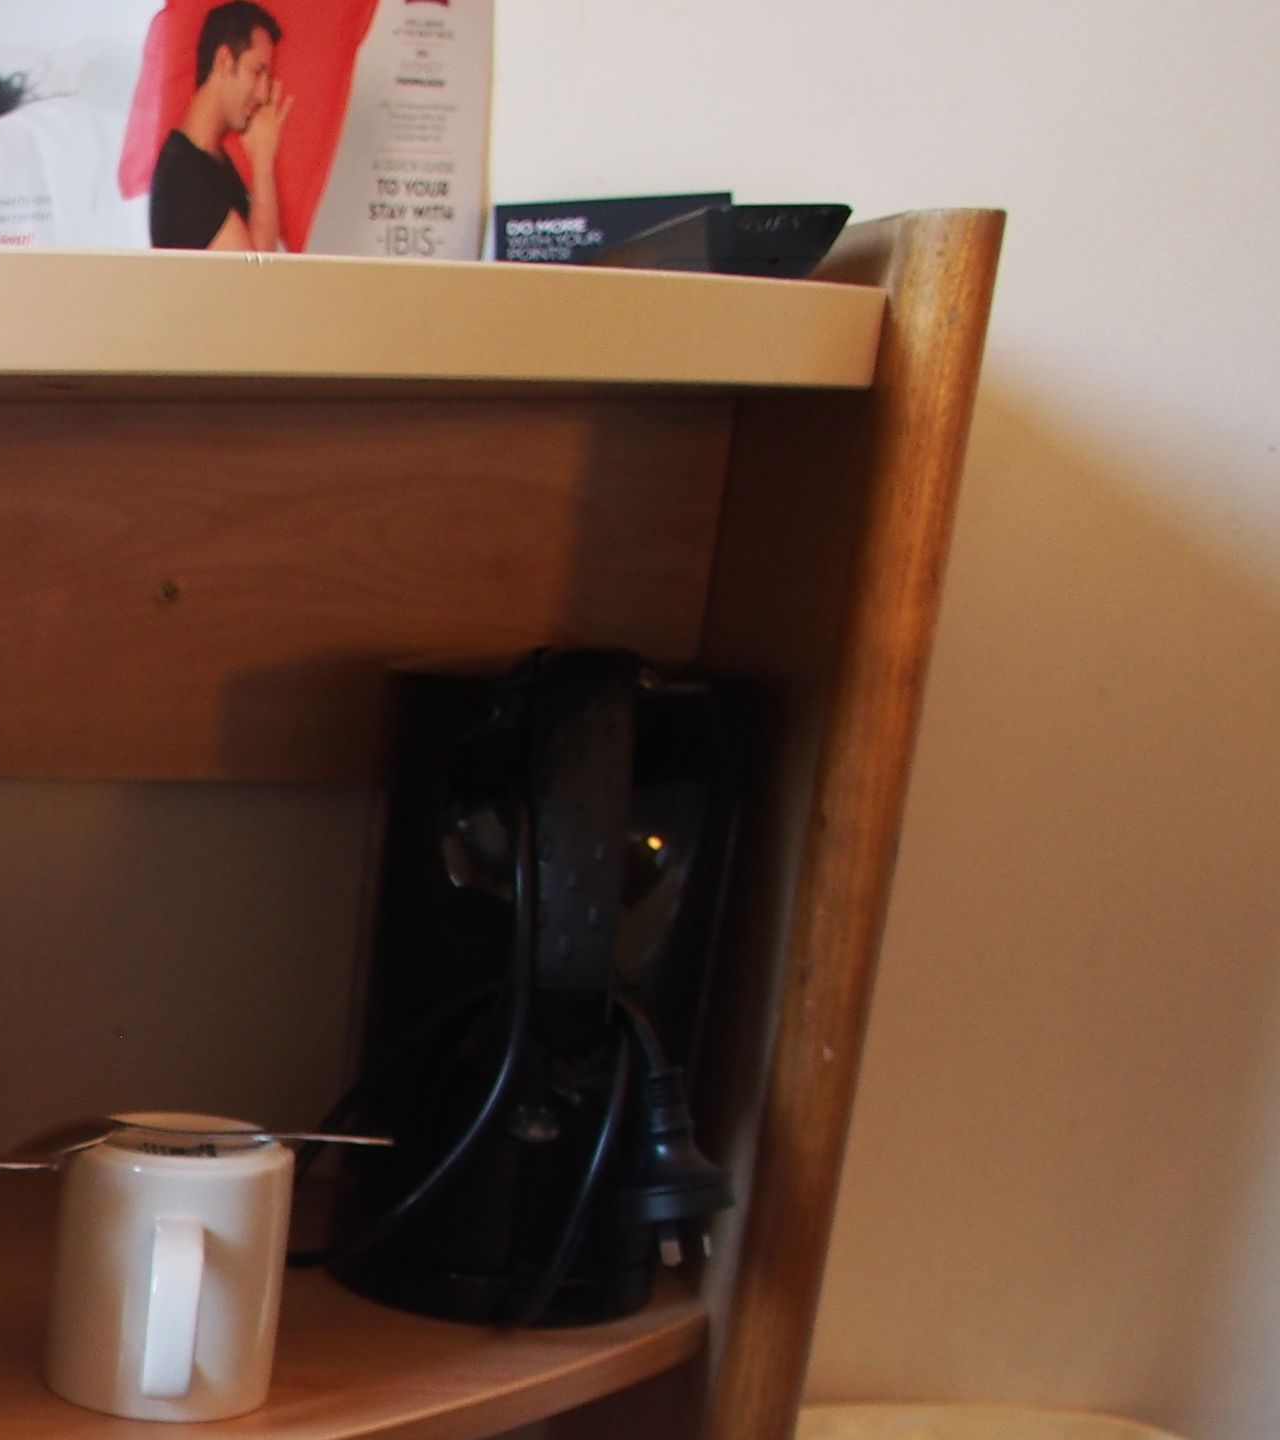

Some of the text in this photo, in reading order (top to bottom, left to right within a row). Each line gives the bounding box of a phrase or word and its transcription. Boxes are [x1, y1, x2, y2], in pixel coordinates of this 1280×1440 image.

[376, 178, 449, 198] TO YOUR
[368, 202, 455, 221] STAY WITH
